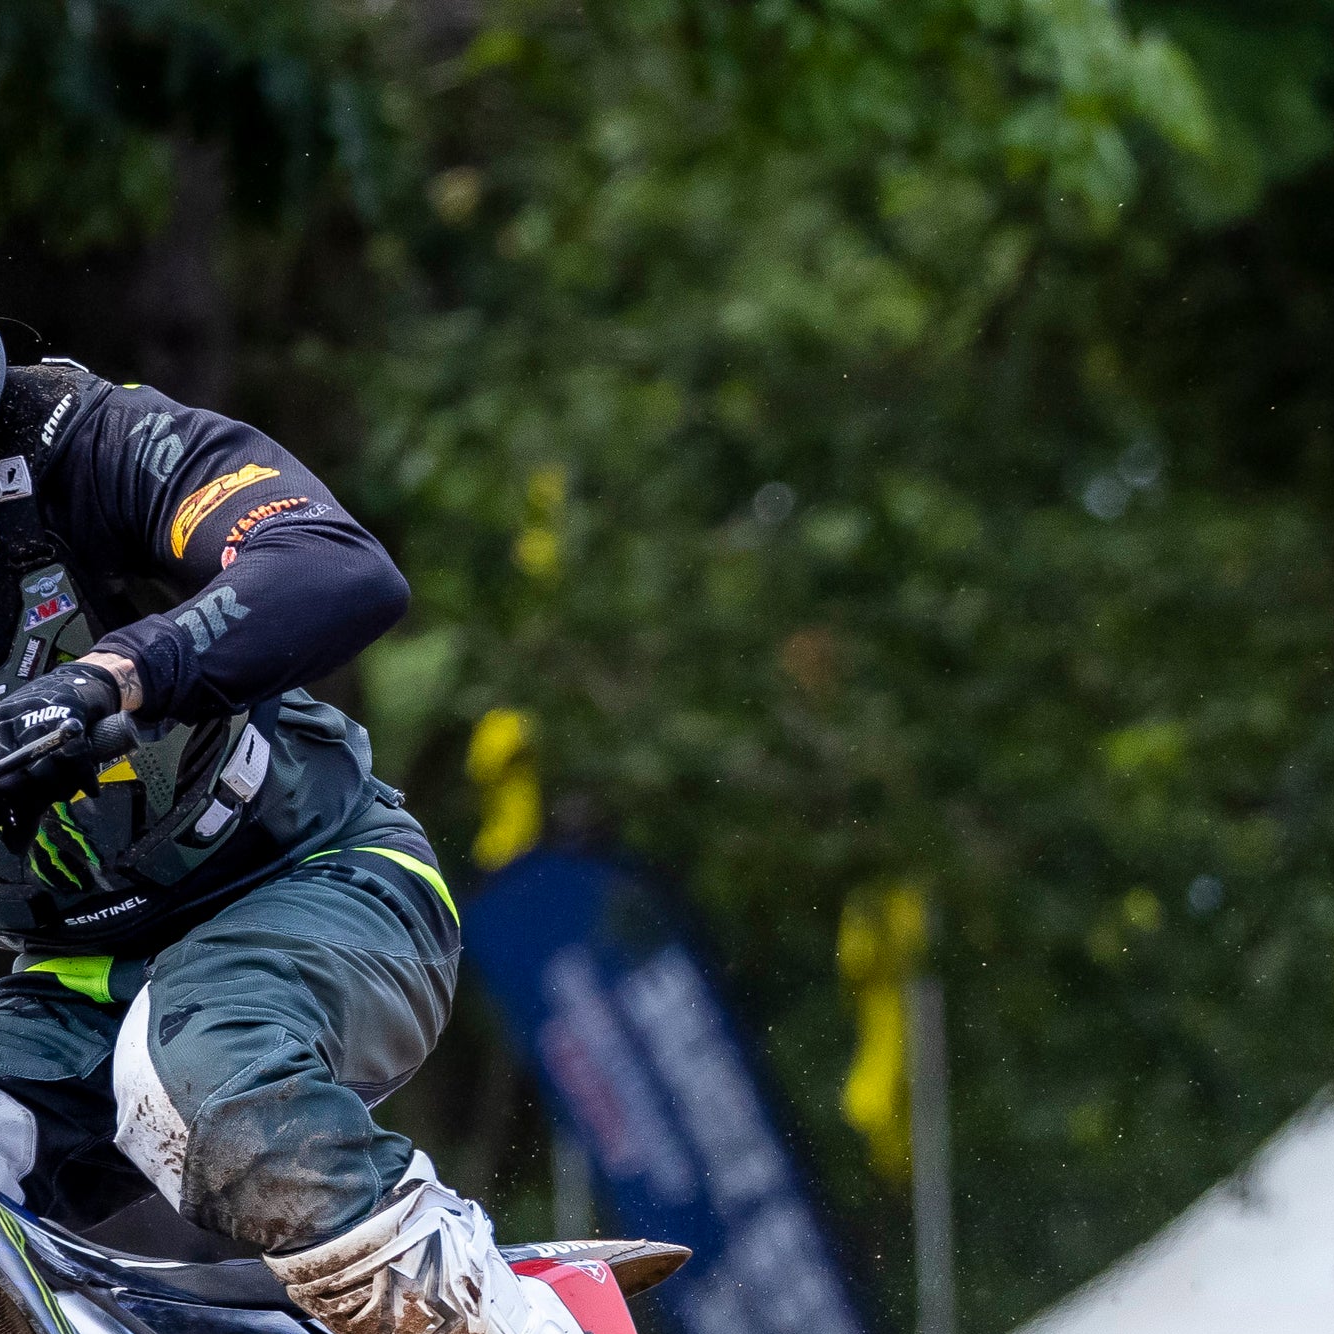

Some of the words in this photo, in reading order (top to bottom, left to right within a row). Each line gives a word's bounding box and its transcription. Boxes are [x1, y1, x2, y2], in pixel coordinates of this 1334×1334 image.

[41, 393, 73, 447] thor
[24, 593, 77, 632] AMA
[16, 638, 41, 678] YAMALUBE
[21, 705, 71, 728] THOR
[64, 895, 148, 927] SENTINEL
